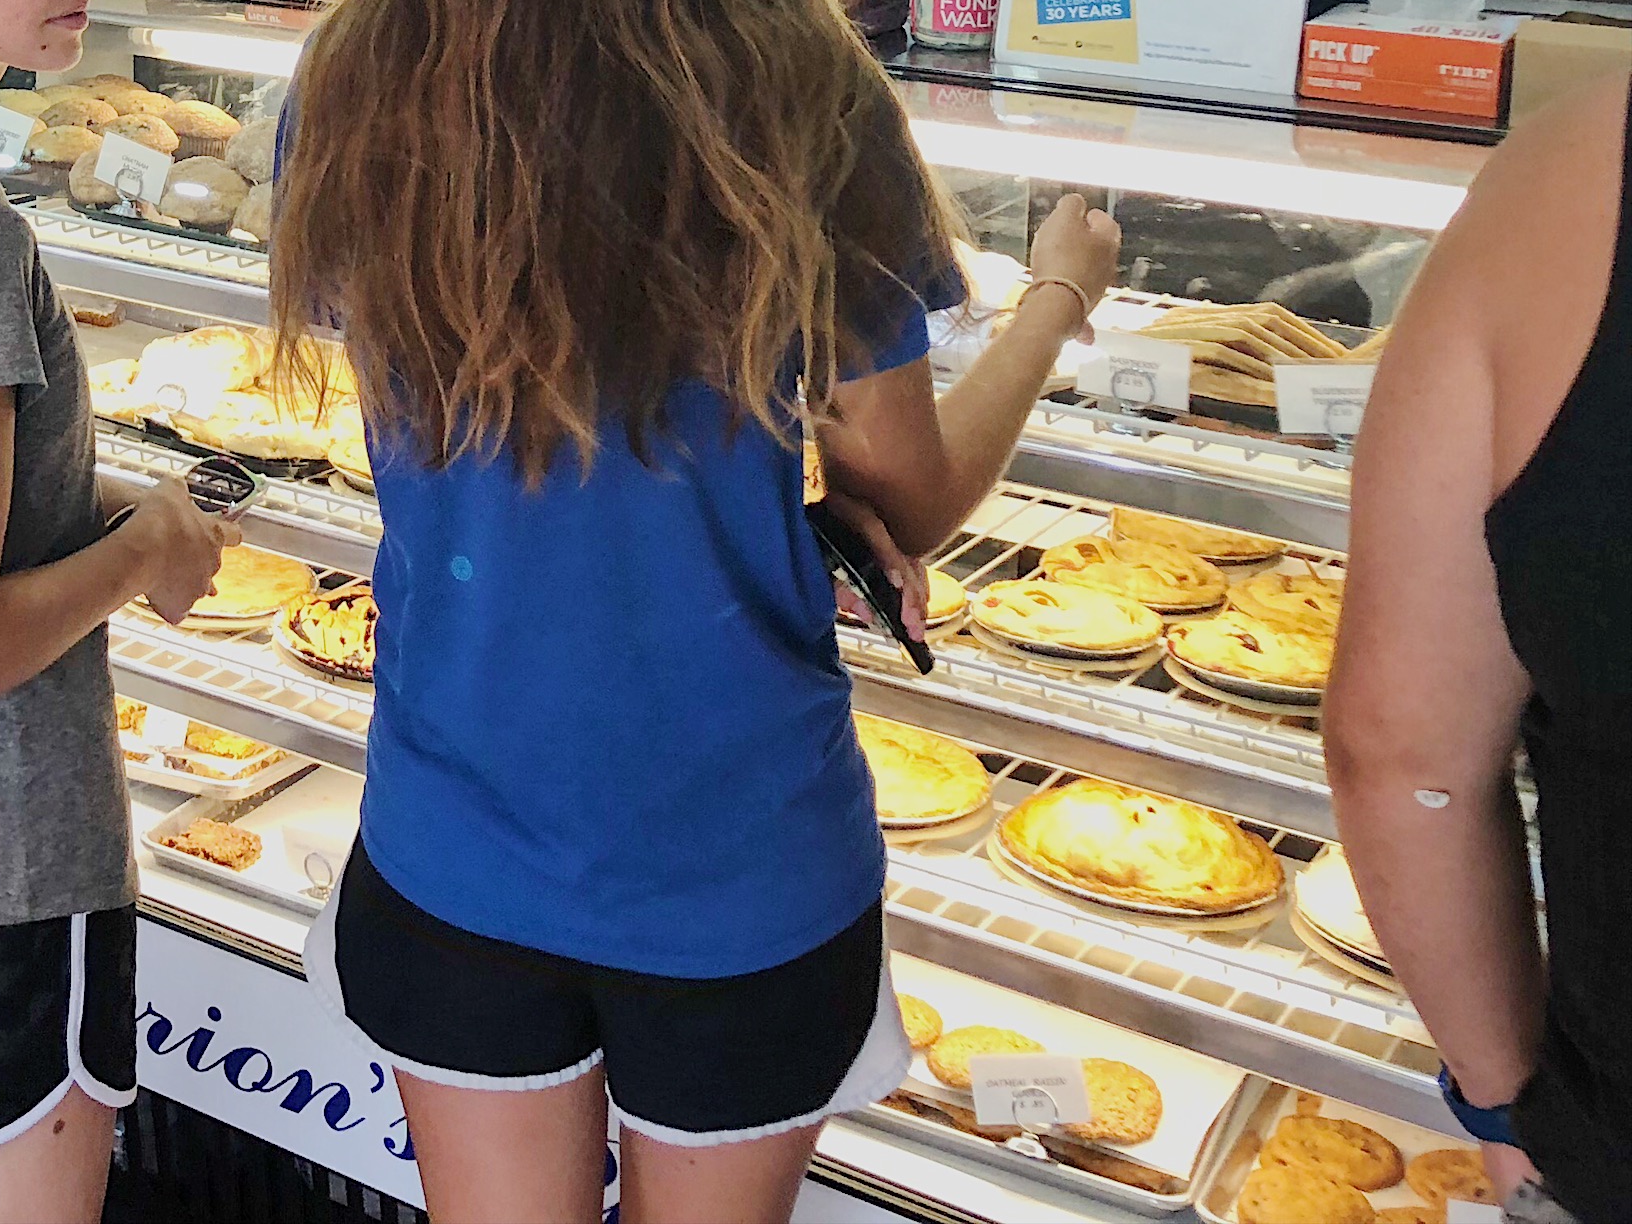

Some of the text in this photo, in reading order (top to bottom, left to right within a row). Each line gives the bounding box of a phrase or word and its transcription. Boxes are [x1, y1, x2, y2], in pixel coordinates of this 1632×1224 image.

[939, 10, 998, 29] WALK
[1045, 3, 1123, 21] 30 YEARS
[1308, 38, 1348, 63] PICK
